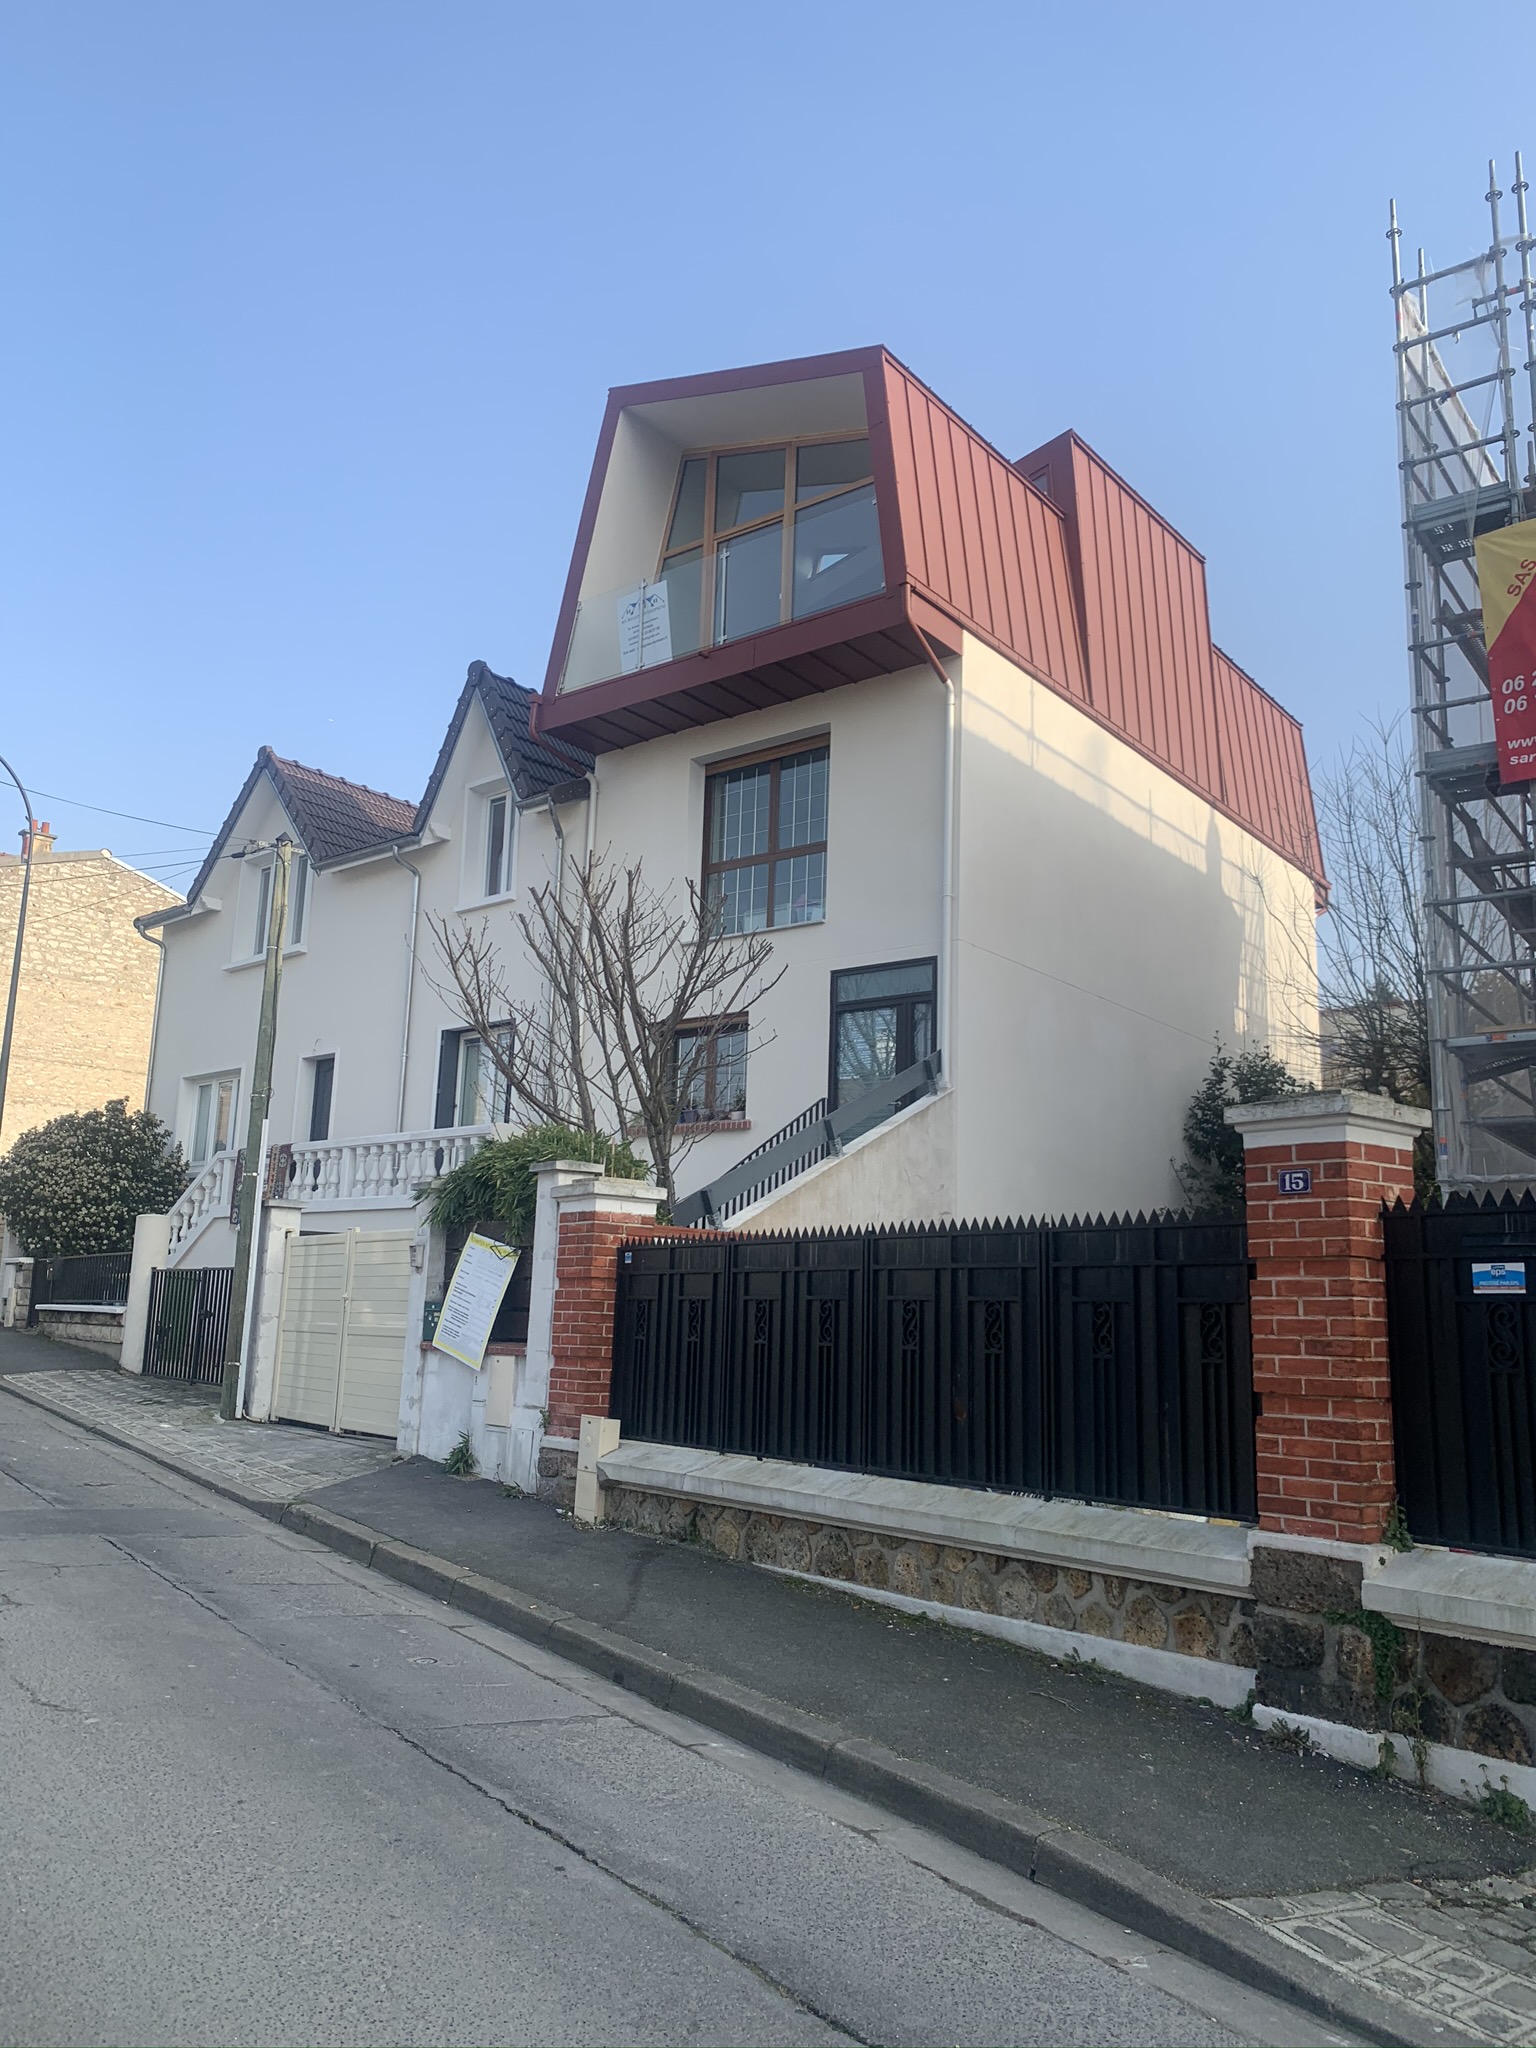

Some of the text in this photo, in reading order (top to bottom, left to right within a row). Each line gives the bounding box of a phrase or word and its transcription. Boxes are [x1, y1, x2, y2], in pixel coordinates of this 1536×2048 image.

[1507, 559, 1536, 597] SAS
[1502, 675, 1525, 694] 06
[1504, 695, 1528, 714] 06
[1507, 736, 1536, 749] ww
[1284, 1173, 1304, 1190] 15
[1491, 1269, 1506, 1277] eps
